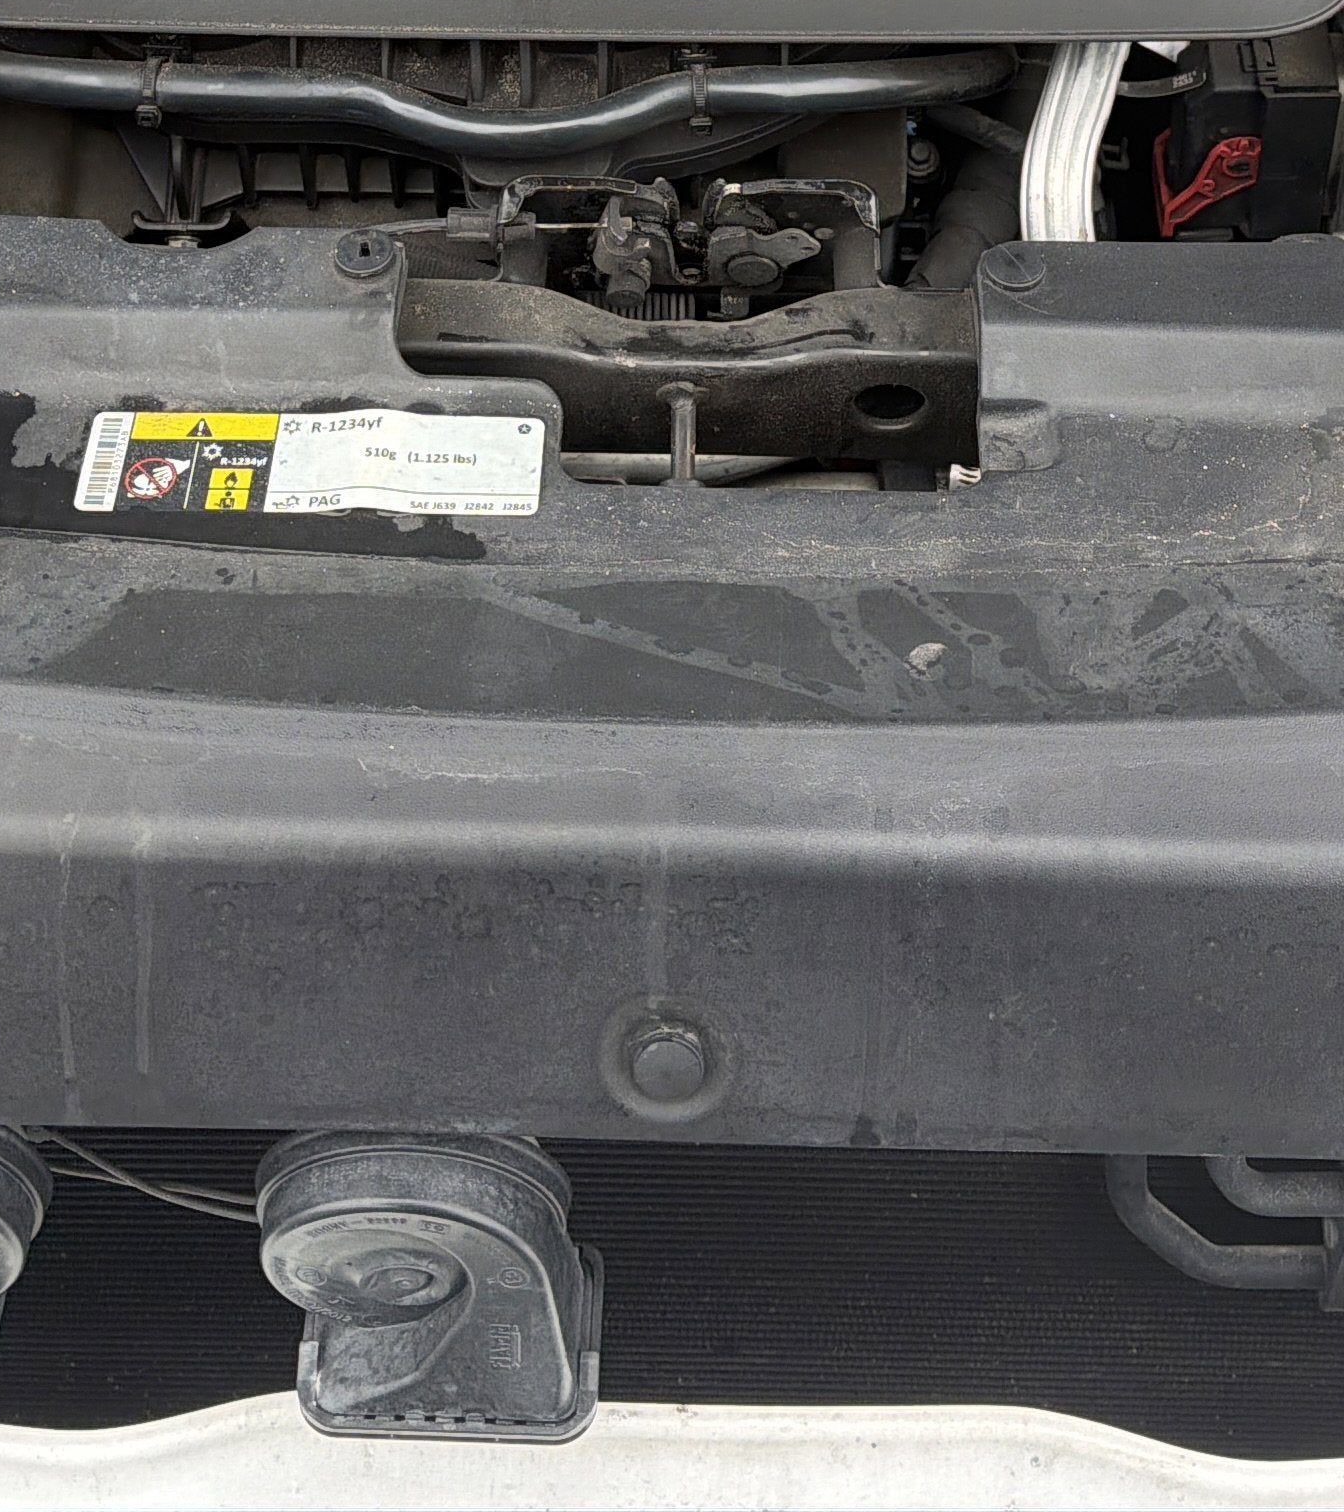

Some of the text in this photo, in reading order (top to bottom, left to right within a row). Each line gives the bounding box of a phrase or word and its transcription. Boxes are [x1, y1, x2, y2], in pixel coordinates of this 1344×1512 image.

[310, 414, 382, 434] R-1234yf
[219, 457, 268, 468] R-1234yf
[364, 448, 477, 466] 510g (1.125 lbs)
[308, 493, 342, 508] PAG
[410, 501, 532, 511] SAE J639 J2842 J2845
